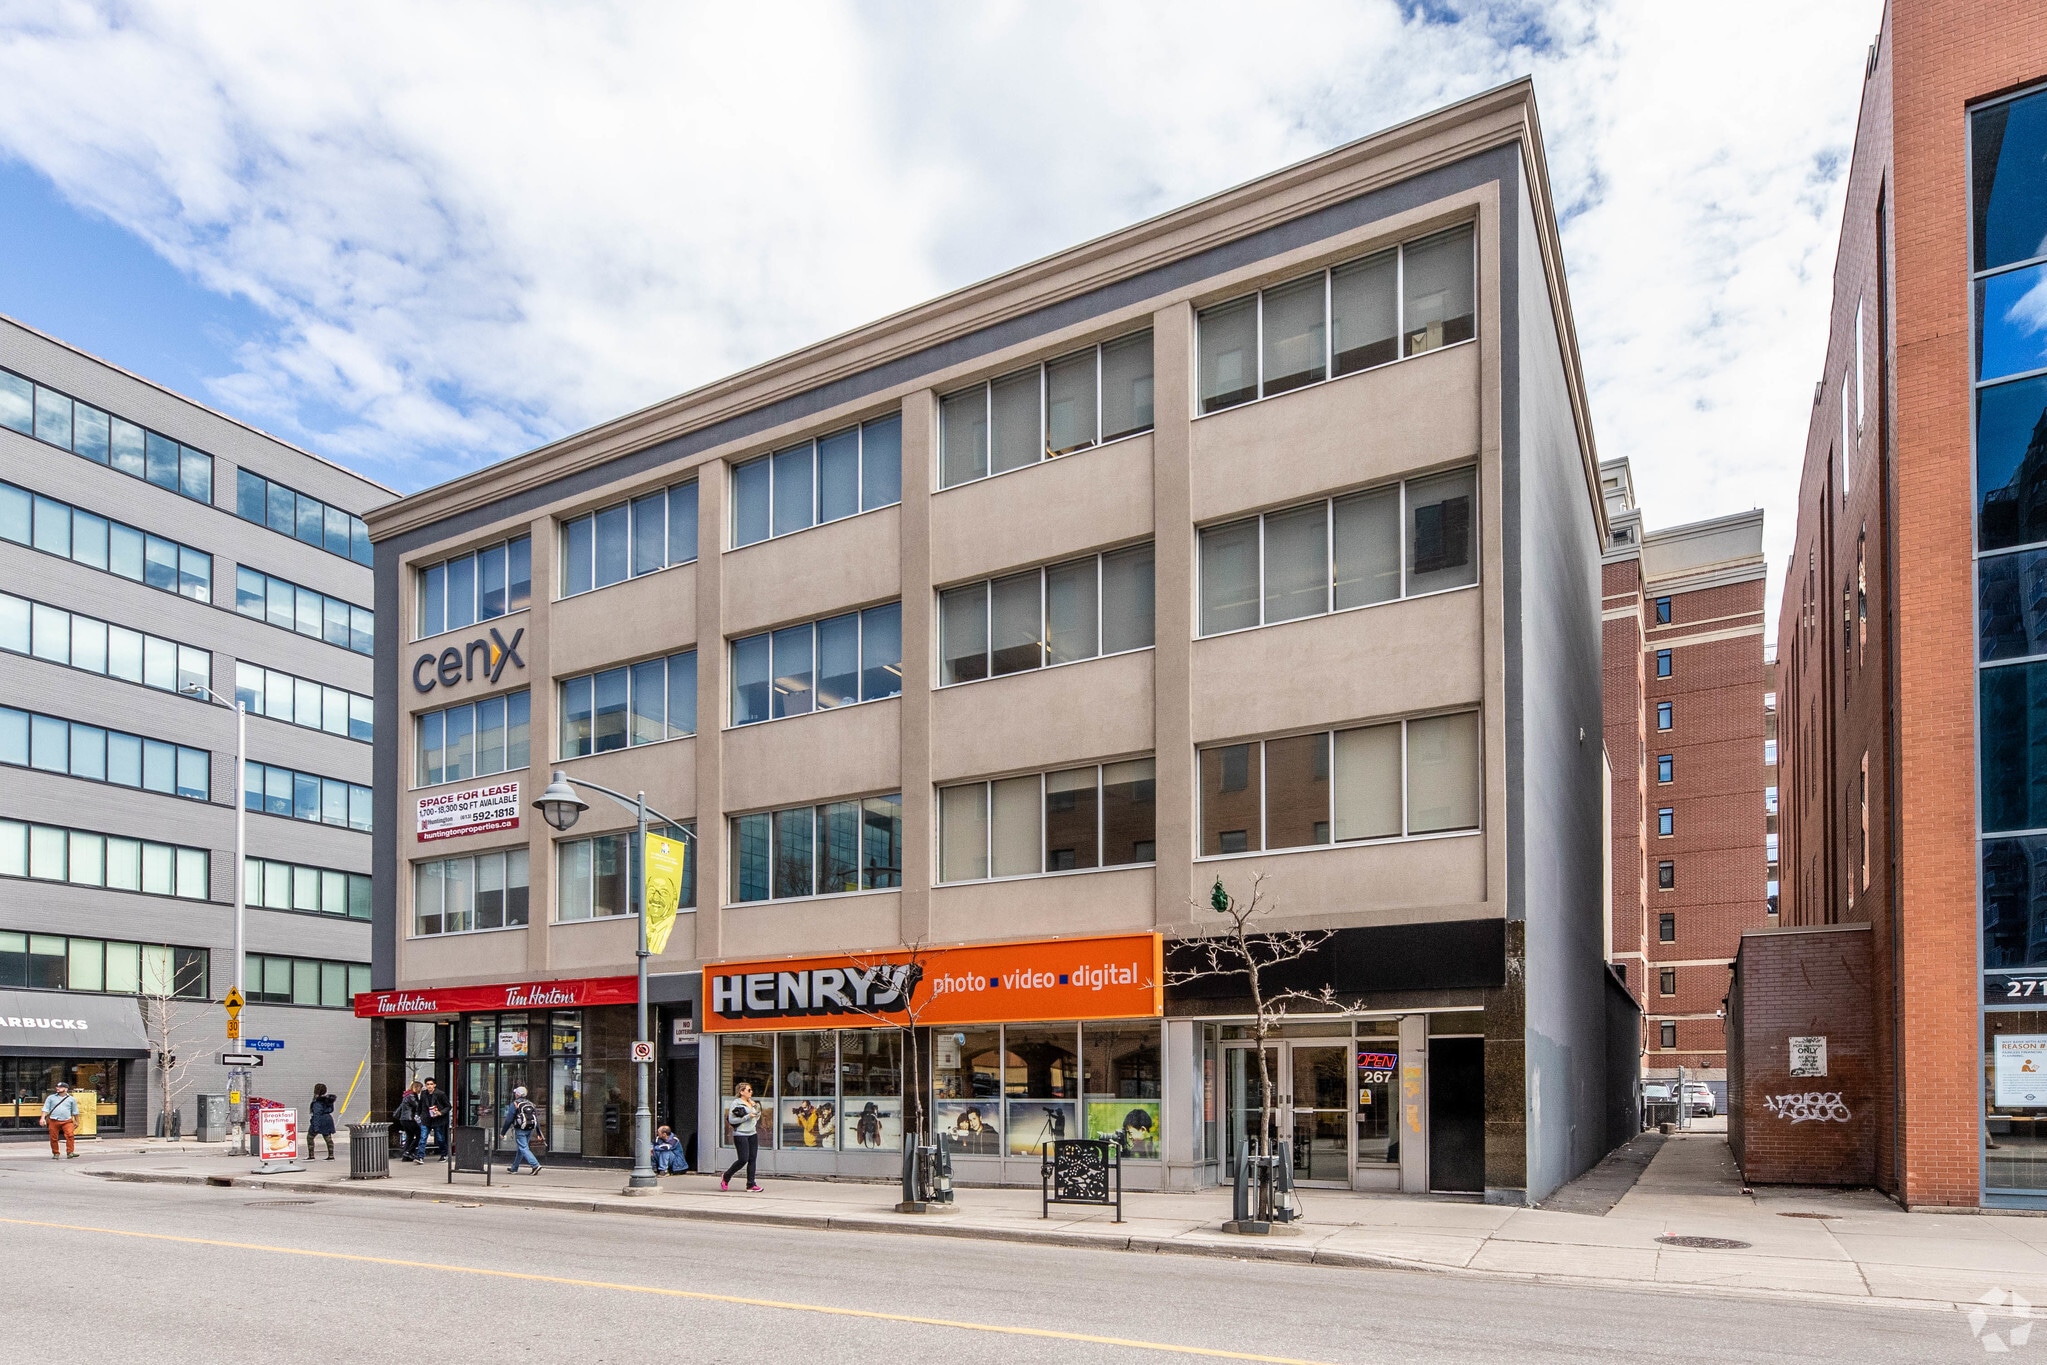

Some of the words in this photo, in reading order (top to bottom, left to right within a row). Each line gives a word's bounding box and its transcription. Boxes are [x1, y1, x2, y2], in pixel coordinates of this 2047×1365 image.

[420, 795, 453, 808] SPACE
[457, 791, 478, 801] FOR
[482, 784, 517, 796] LEASE
[438, 804, 457, 814] 18,300
[458, 803, 468, 811] SQ
[469, 801, 478, 809] FT
[480, 794, 517, 808] AVAILABLE
[472, 807, 515, 821] 592-1818
[424, 820, 512, 839] huntingtonproperties.ca
[933, 971, 986, 998] photo
[1003, 968, 1055, 990] video
[1071, 962, 1138, 991] digital
[2007, 980, 2047, 996] 271
[377, 994, 396, 1013] Tim
[397, 993, 437, 1011] Hortons
[505, 986, 527, 1006] Tim
[528, 985, 574, 1005] Hortons
[229, 1022, 238, 1031] 30
[1797, 1047, 1818, 1055] ONLY
[1357, 1053, 1395, 1068] OPEN
[1364, 1071, 1393, 1084] 267
